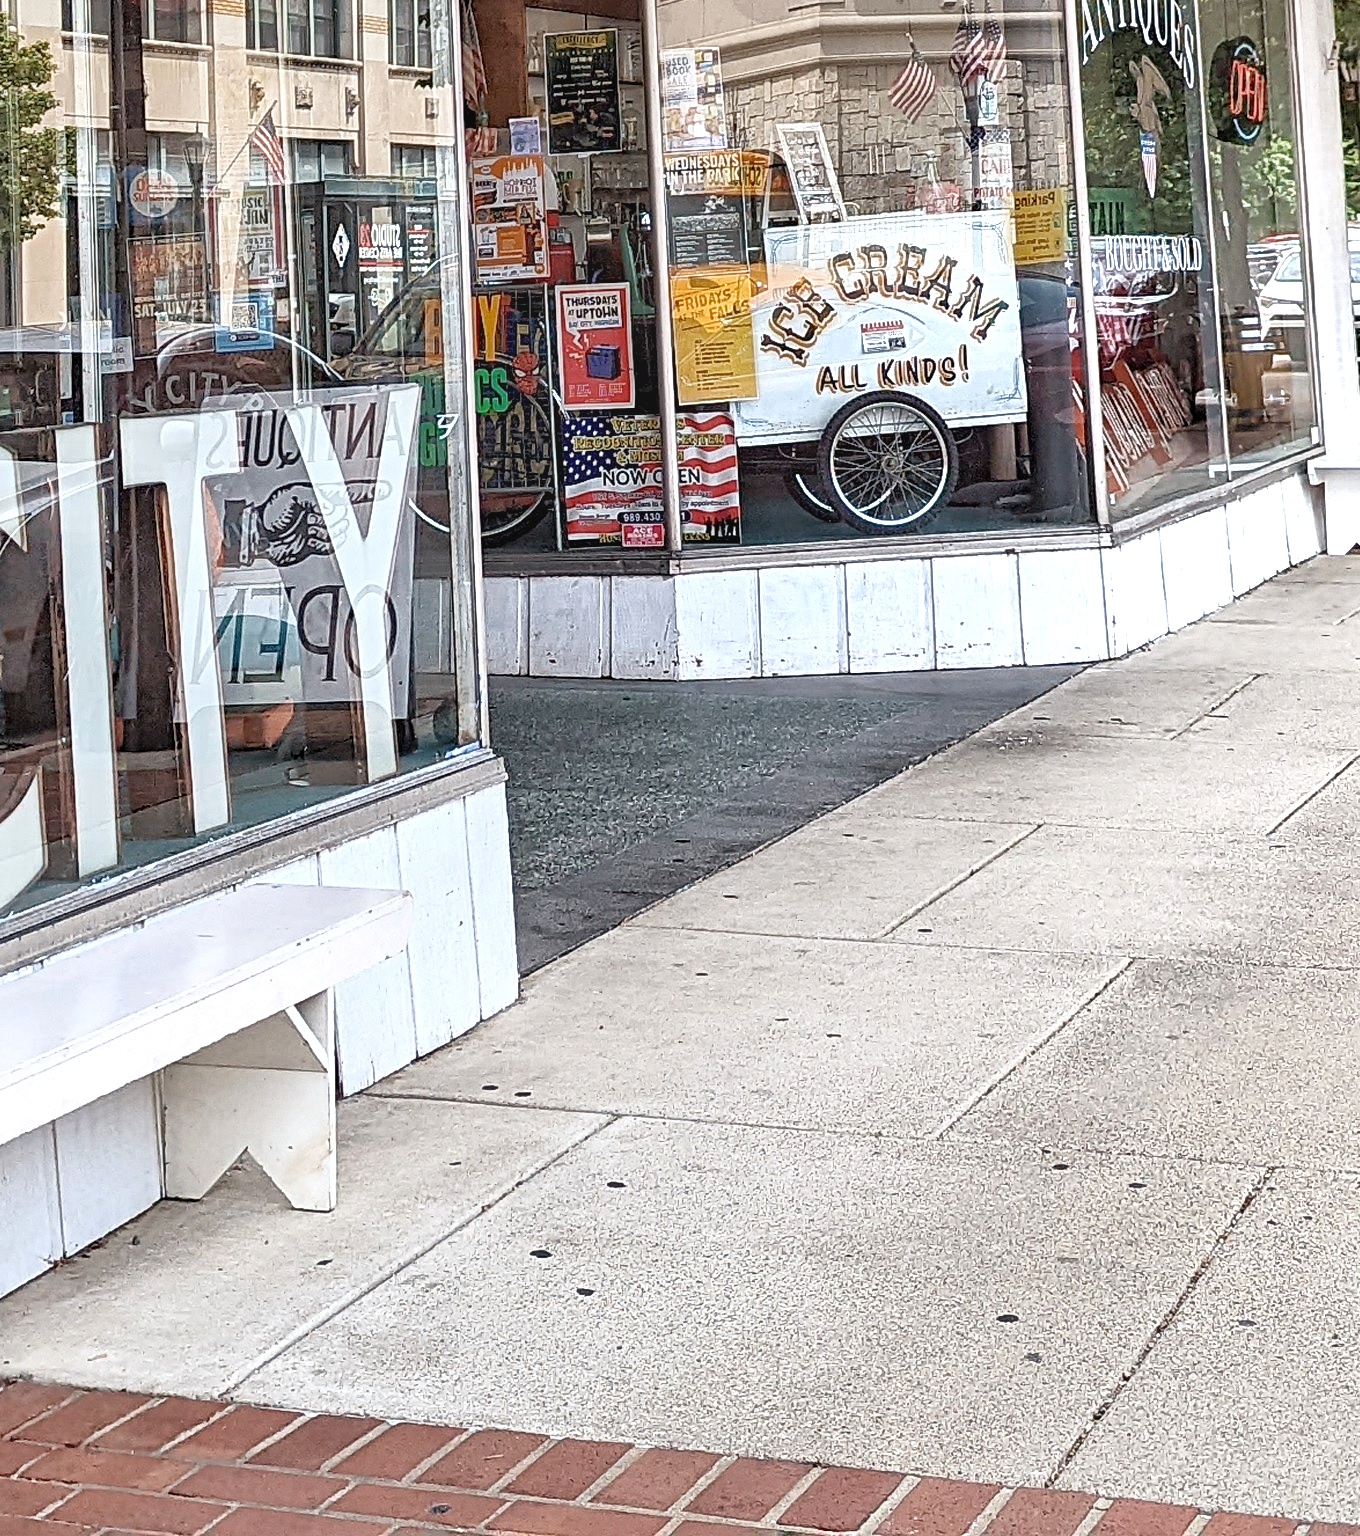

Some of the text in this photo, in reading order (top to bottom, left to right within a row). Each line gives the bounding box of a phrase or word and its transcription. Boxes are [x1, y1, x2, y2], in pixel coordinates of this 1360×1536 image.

[1229, 59, 1269, 125] OPEN
[664, 152, 739, 171] WEDNESDAYS
[666, 170, 679, 185] IN
[682, 169, 705, 184] THE
[706, 166, 740, 183] PARK
[1105, 234, 1203, 272] BOUGHT & SOLD
[565, 295, 618, 307] THURSDAYS
[674, 288, 731, 312] FRIDAYS
[709, 299, 750, 321] FALLS
[760, 276, 837, 368] ICE
[828, 242, 1010, 343] CREAM
[576, 306, 619, 319] UPTOWN
[816, 344, 970, 395] ALL KINDS!
[611, 417, 686, 433] VETERS
[603, 467, 701, 486] NOW OEN
